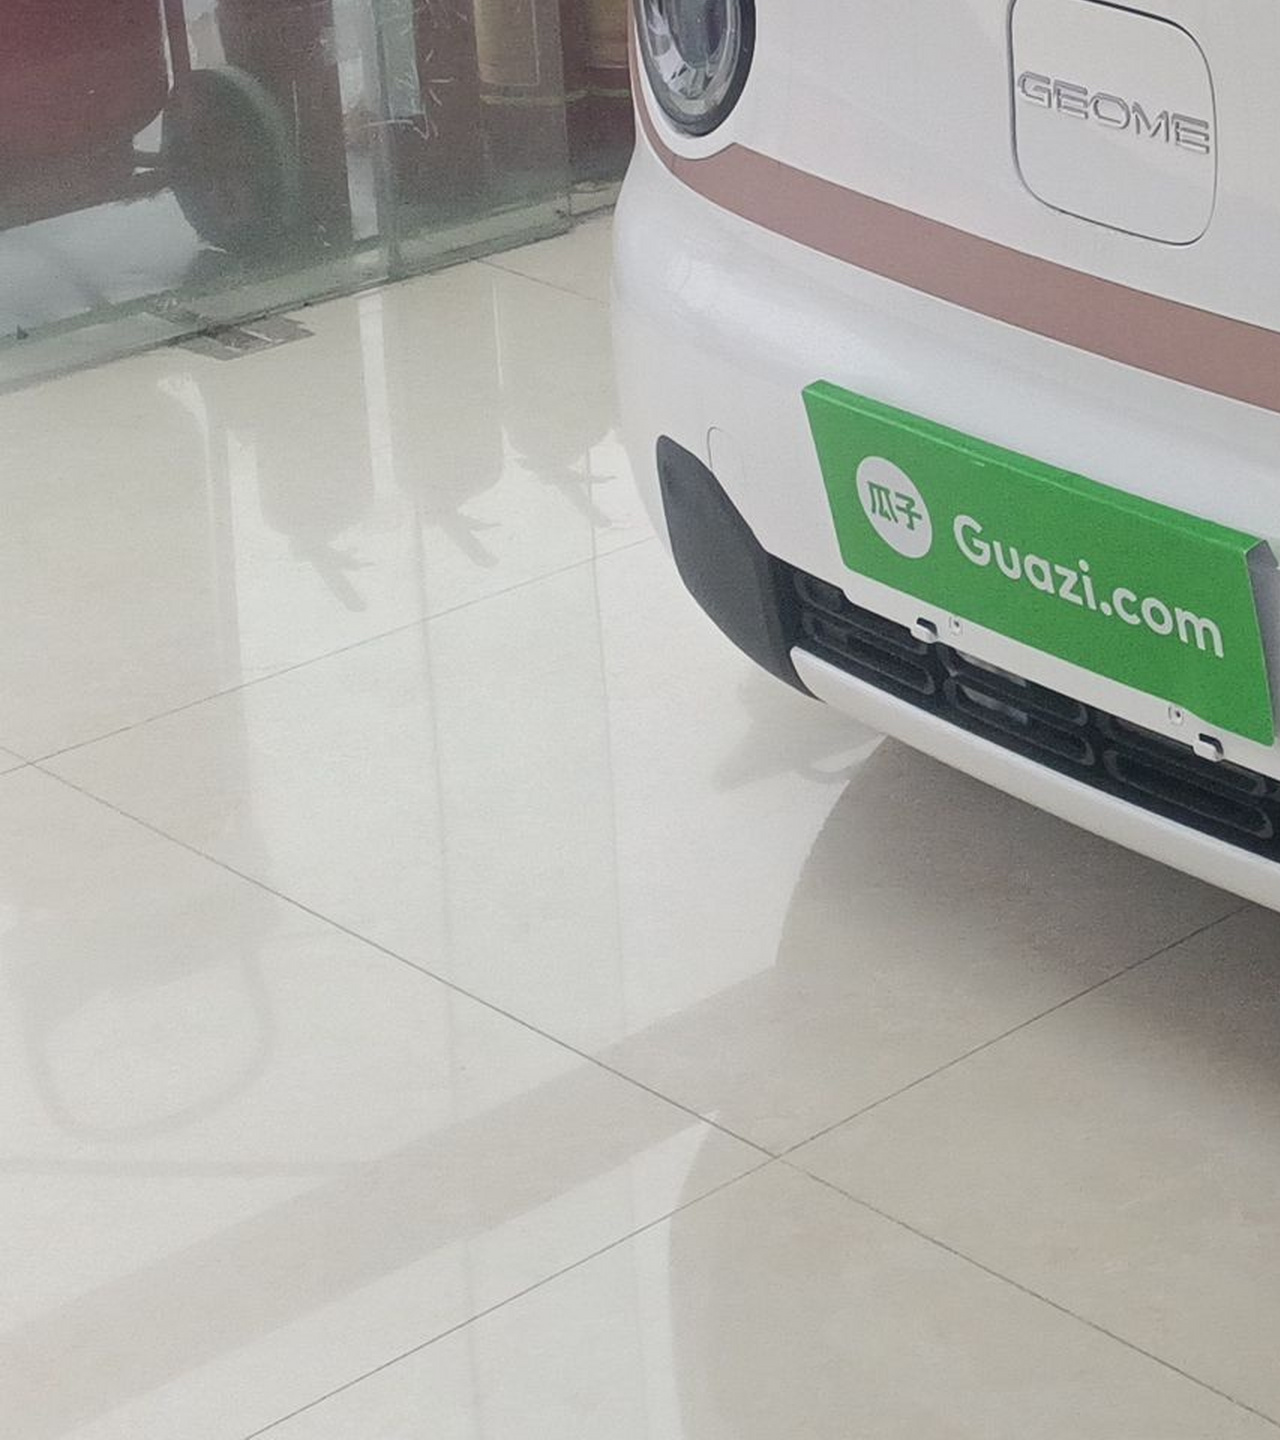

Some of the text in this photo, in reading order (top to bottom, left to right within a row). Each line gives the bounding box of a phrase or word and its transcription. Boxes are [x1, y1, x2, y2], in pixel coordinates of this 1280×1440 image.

[1017, 70, 1209, 155] GEOME
[867, 479, 923, 531] 瓜子
[952, 513, 1225, 660] Guazi.com
